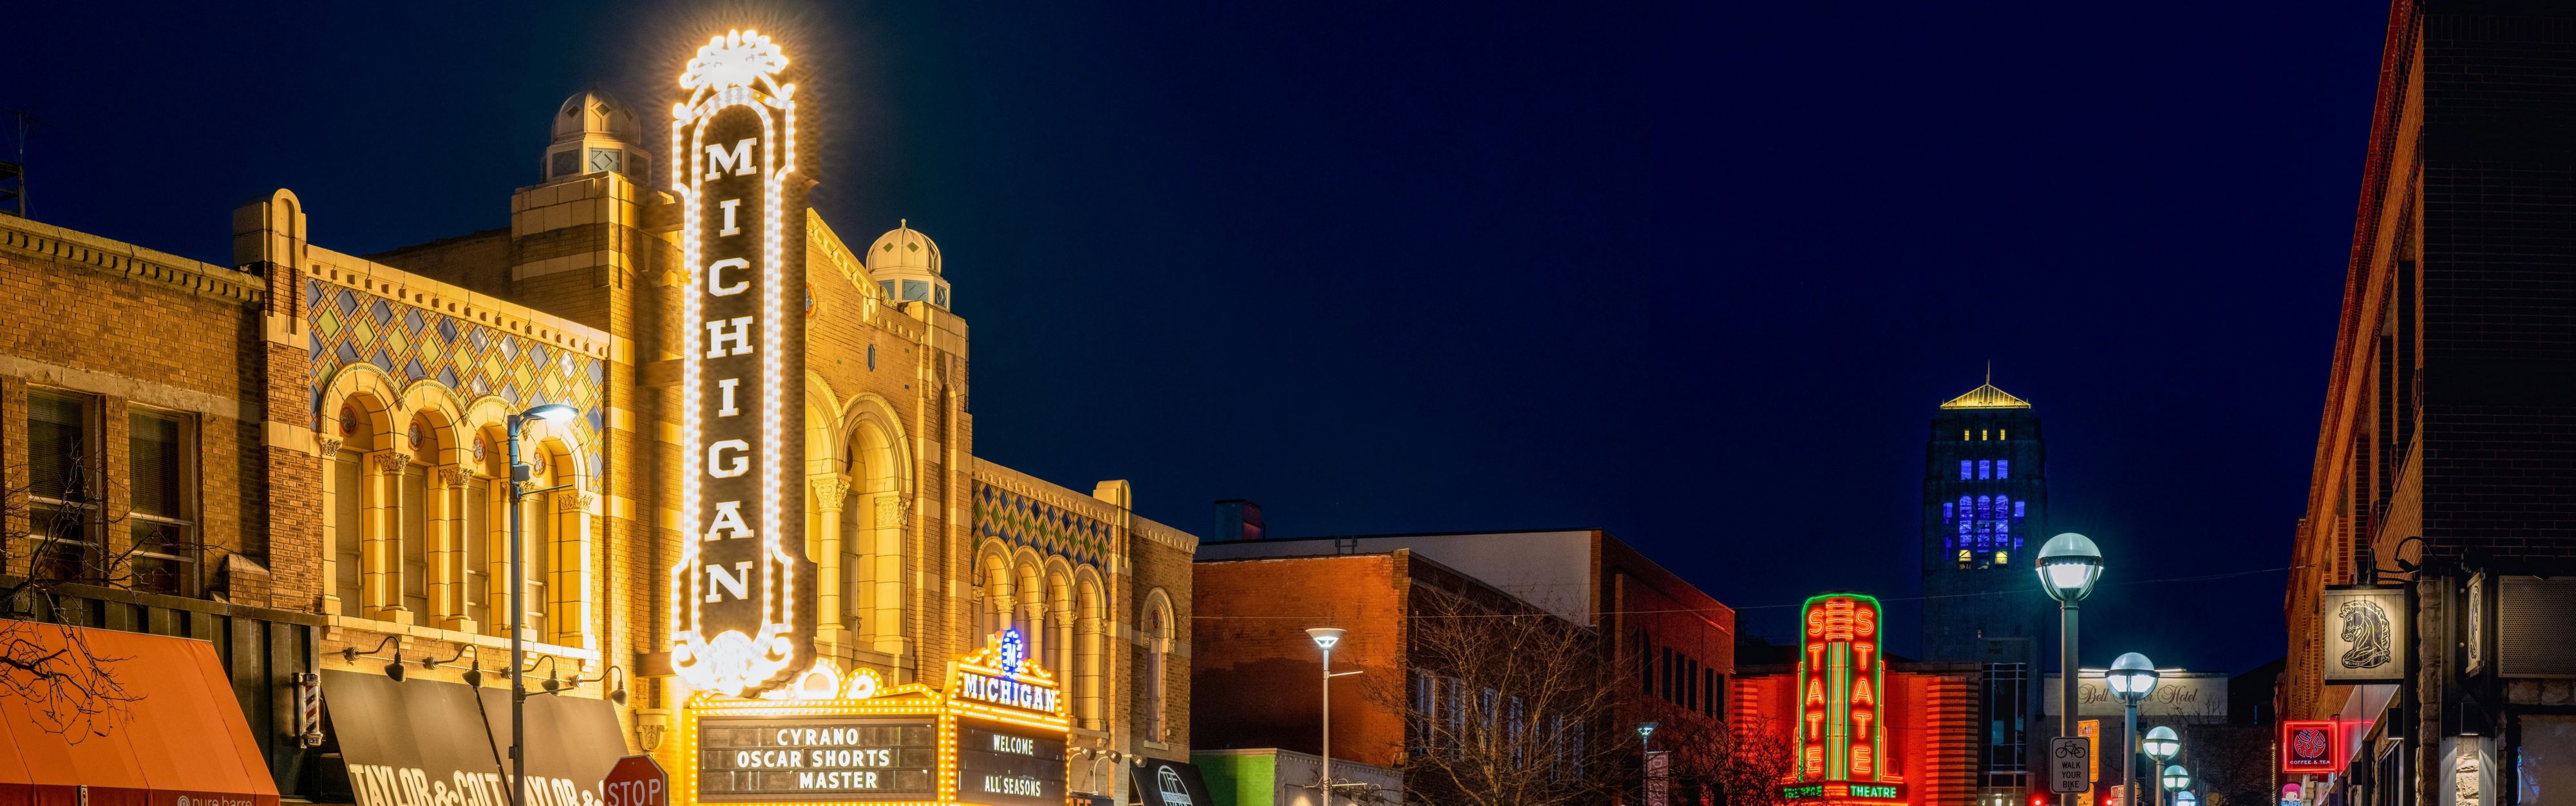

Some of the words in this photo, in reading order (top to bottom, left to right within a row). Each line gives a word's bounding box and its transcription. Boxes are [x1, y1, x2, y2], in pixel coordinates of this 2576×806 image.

[704, 137, 757, 604] MICHIGAN
[1007, 643, 1016, 667] M
[963, 673, 1056, 713] MICHIGAN
[1806, 609, 1824, 773] STATE
[1853, 609, 1873, 773] STATE
[2078, 684, 2109, 704] Bell
[2157, 685, 2198, 704] Hotel
[777, 729, 858, 745] CYRANO
[994, 734, 1034, 755] WELCOME
[737, 750, 802, 767] OSCAR
[812, 749, 890, 767] SHORTS
[349, 763, 435, 806] TAYLOR
[434, 780, 459, 806] &
[508, 774, 580, 806] AYLOR
[800, 771, 877, 789] MASTER
[985, 776, 1001, 792] ALL
[1004, 778, 1041, 797] SEASONS
[608, 778, 661, 806] STOP
[1850, 785, 1897, 798] THEATRE
[2112, 789, 2118, 798] NO
